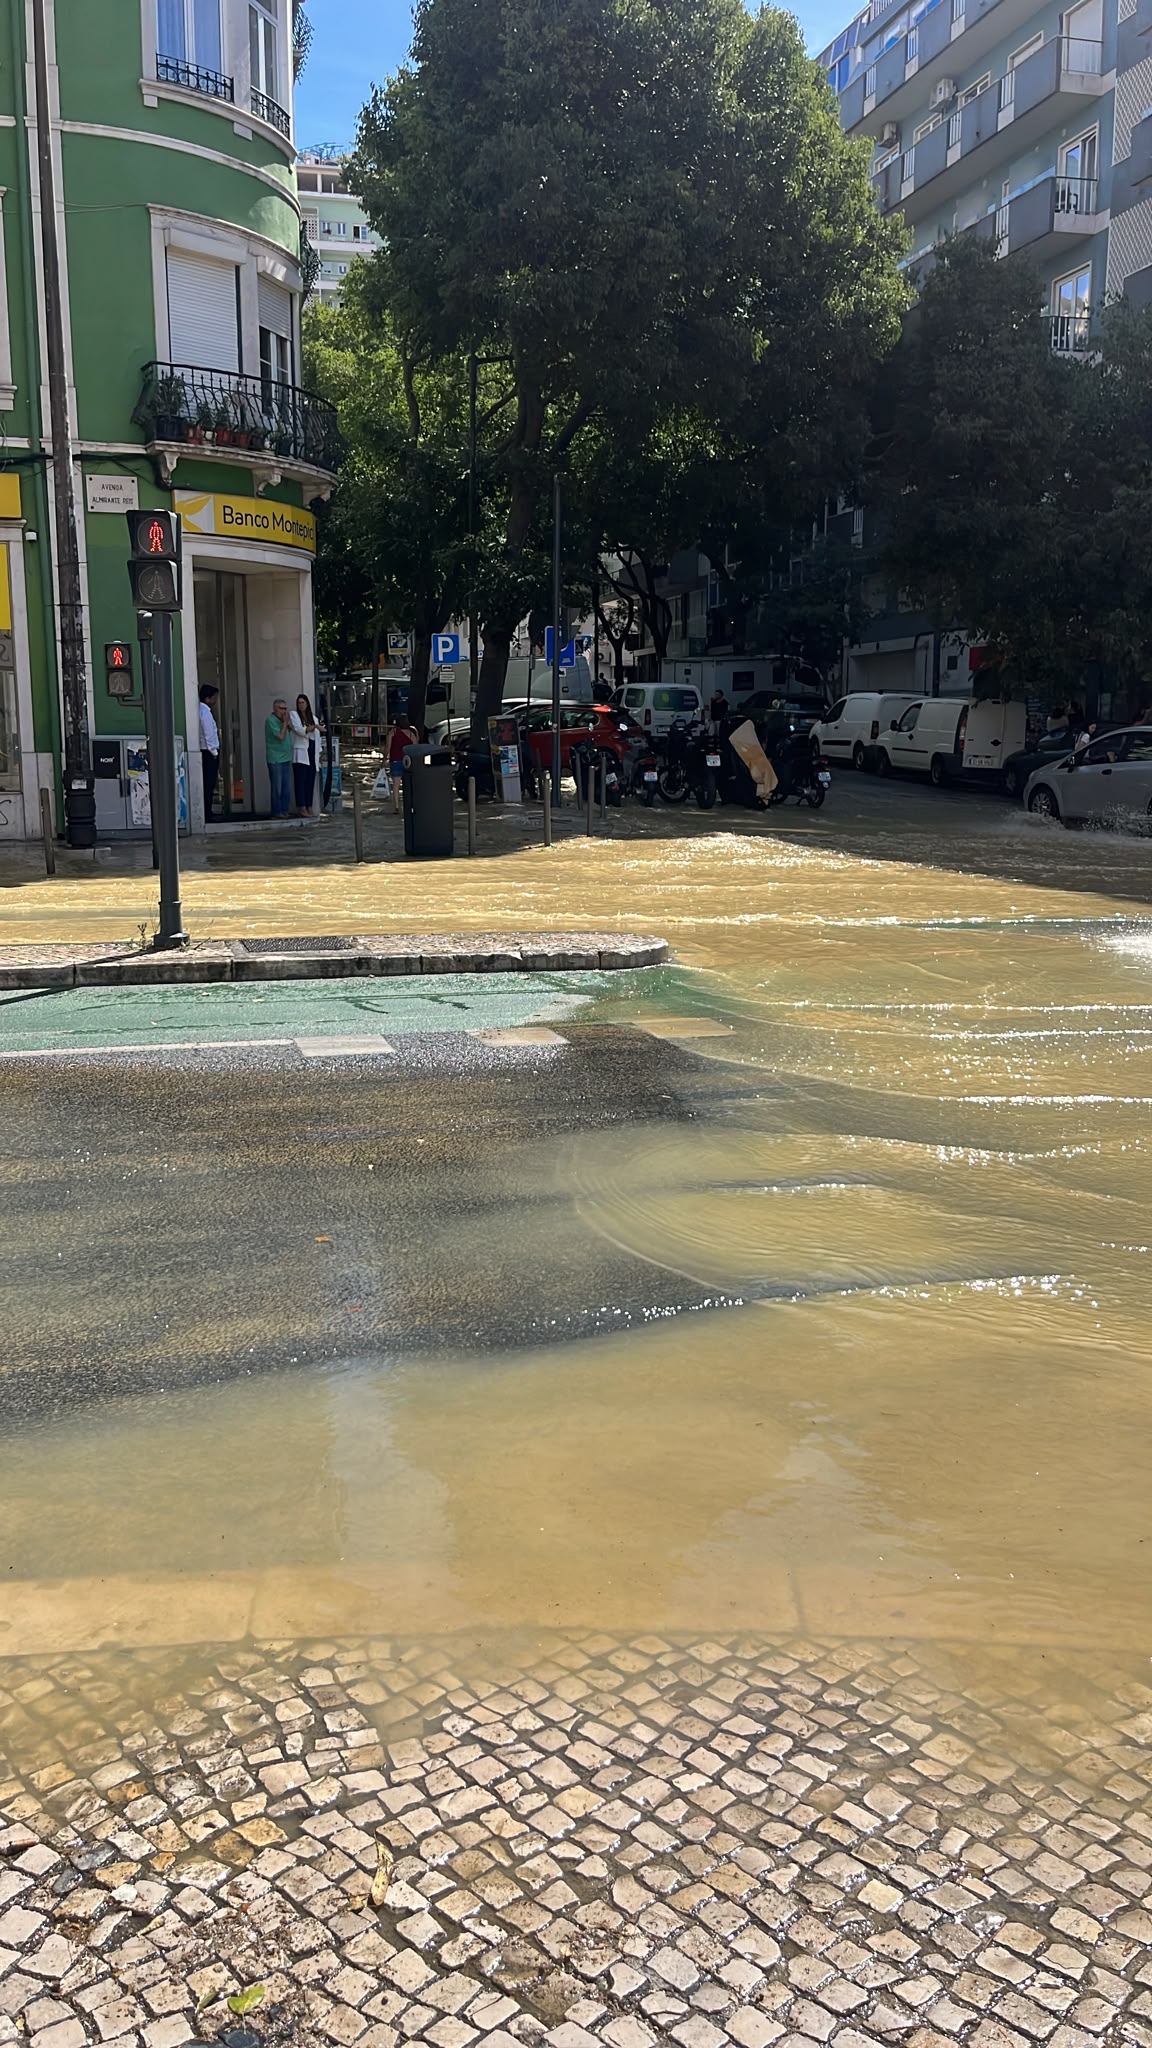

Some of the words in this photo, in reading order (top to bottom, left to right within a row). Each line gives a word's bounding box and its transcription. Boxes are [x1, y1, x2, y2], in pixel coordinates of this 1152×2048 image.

[92, 496, 121, 505] ALMIRANTE
[222, 505, 270, 529] Banco
[390, 635, 398, 647] P
[437, 636, 454, 662] P
